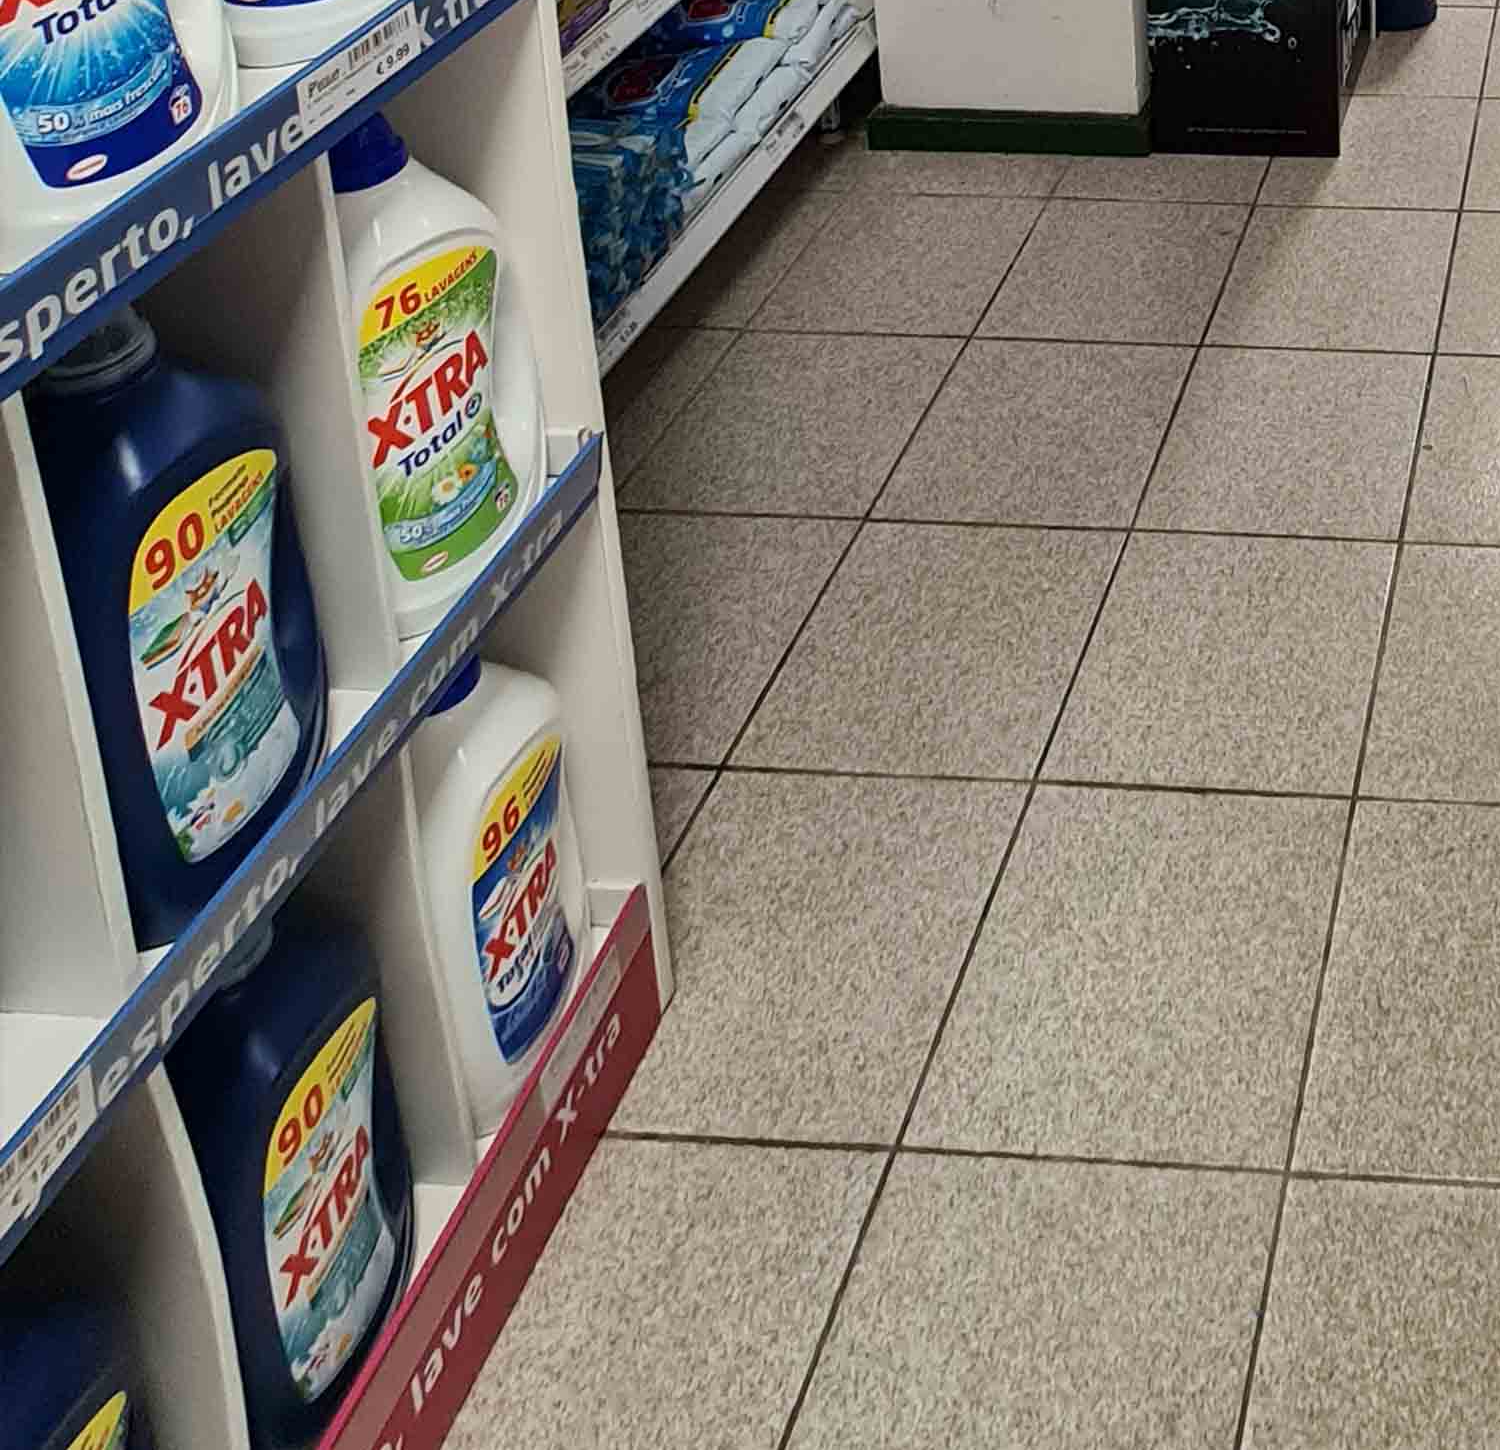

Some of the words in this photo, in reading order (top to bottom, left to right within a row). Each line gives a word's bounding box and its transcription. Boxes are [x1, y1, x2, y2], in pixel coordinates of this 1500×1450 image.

[38, 111, 71, 134] 50
[207, 114, 303, 212] lave
[375, 281, 422, 332] 76
[424, 251, 478, 304] LAVAGENS
[398, 410, 463, 478] Total
[144, 511, 206, 591] 90
[99, 854, 303, 1111] esperto,
[312, 721, 400, 836] lave
[412, 620, 485, 720] com
[487, 509, 565, 619] X-tra
[481, 796, 521, 863] 96
[278, 1084, 325, 1168] 90
[410, 1274, 485, 1416] lave
[490, 1147, 552, 1265] com
[556, 1013, 622, 1143] X-tra
